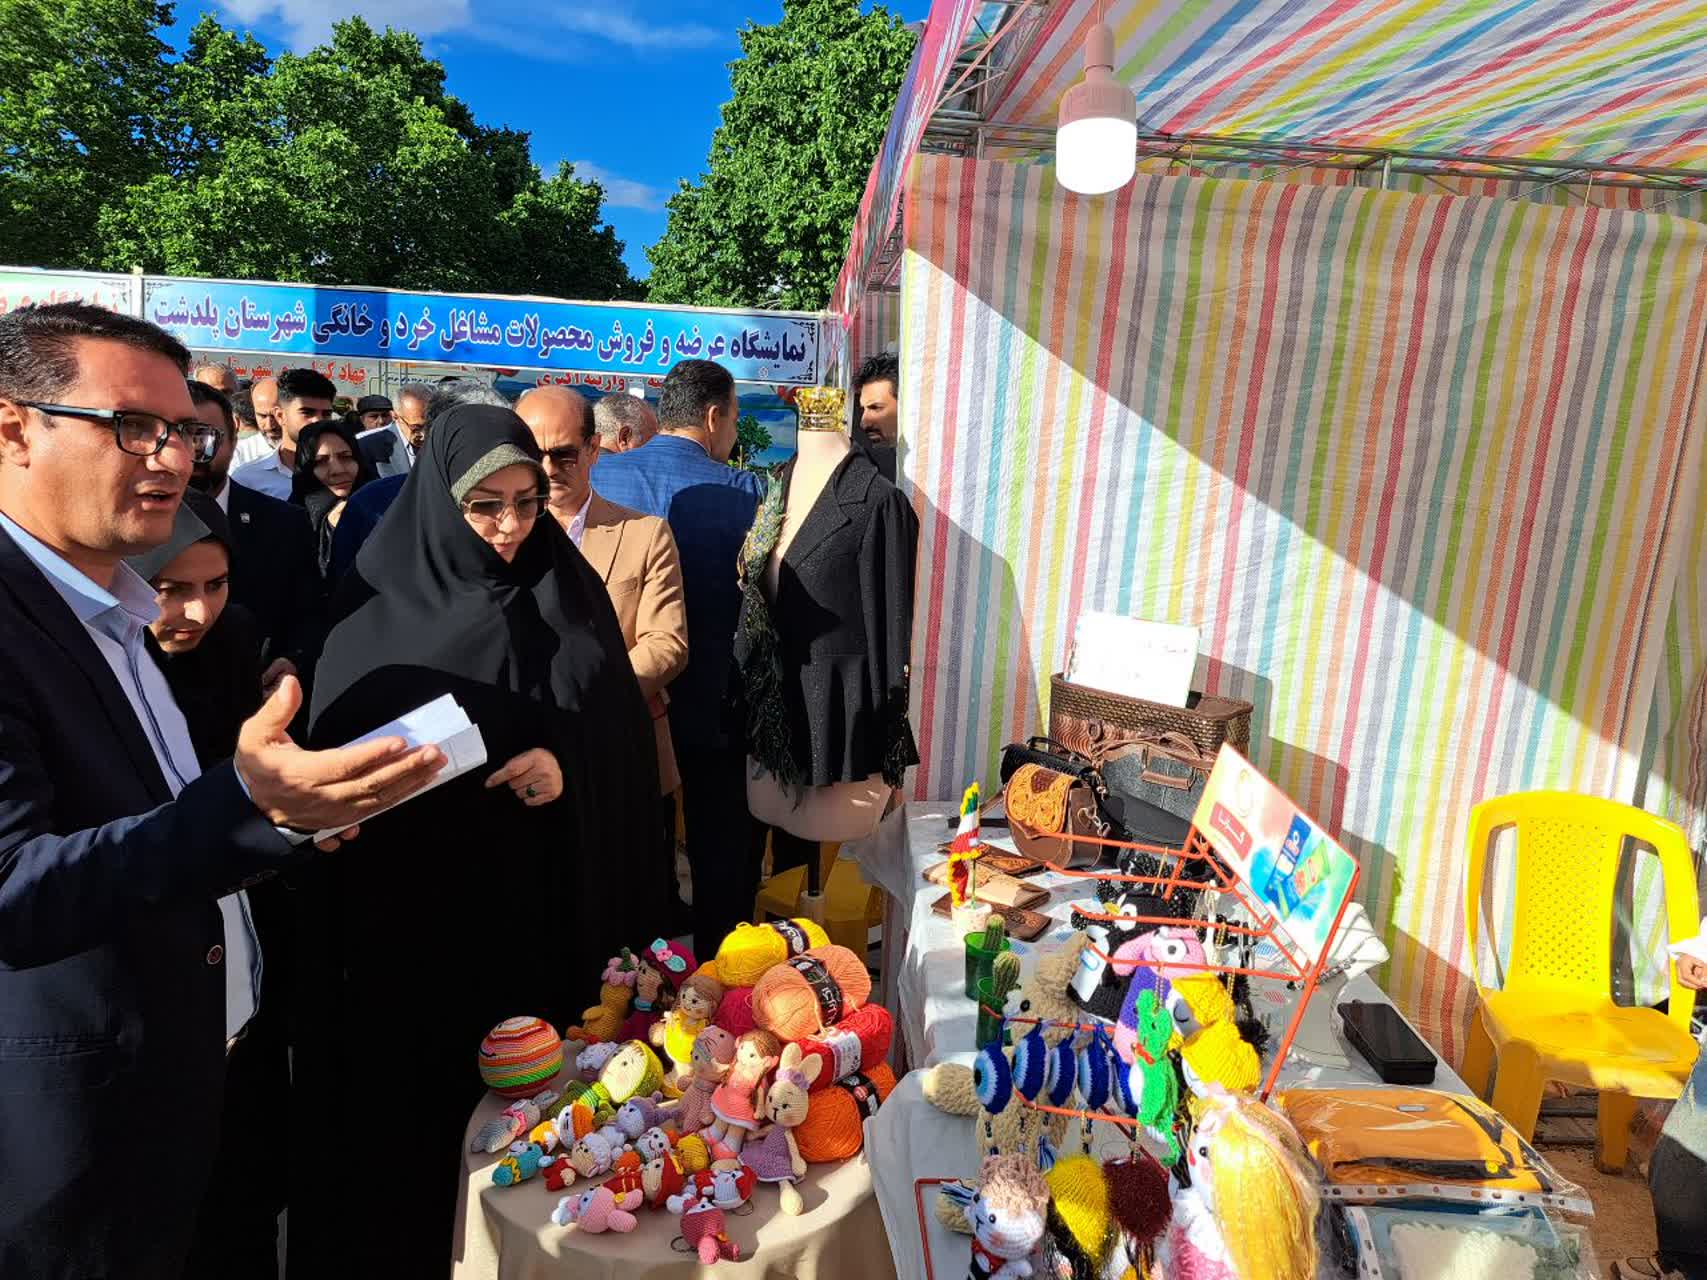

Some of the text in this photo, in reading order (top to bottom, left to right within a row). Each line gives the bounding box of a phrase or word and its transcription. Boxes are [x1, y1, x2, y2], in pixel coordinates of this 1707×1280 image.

[154, 294, 219, 339] پلدشت
[224, 295, 307, 342] شهرستان
[311, 303, 374, 344] خانگی
[378, 319, 391, 348] و
[395, 307, 436, 350] خرد
[440, 308, 502, 351] مشاغل
[505, 313, 593, 358] محصولات
[598, 319, 655, 364] فروش
[658, 336, 670, 365] و
[676, 325, 725, 361] عرضه
[731, 329, 806, 368] نمایشگاه
